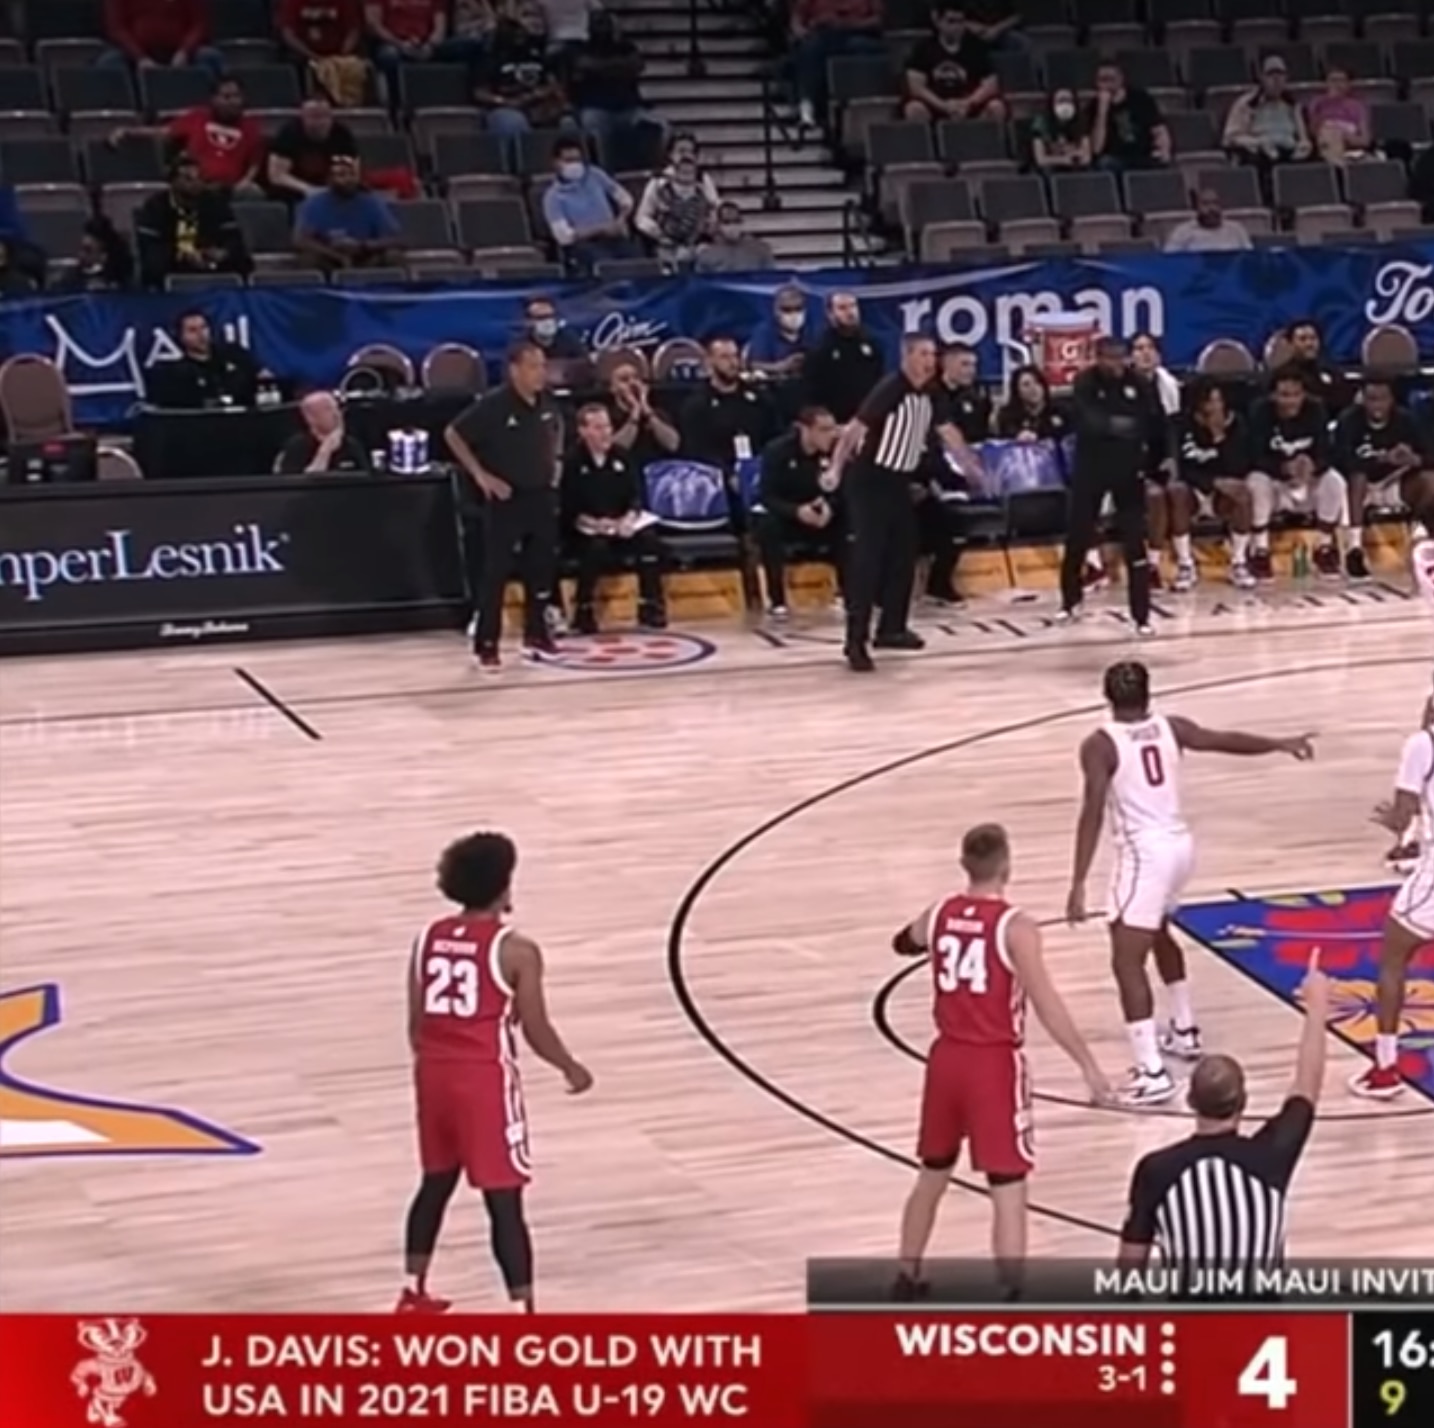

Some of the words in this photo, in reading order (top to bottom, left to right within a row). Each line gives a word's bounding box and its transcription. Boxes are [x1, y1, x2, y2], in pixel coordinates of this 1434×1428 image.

[1141, 744, 1165, 787] 0
[425, 955, 478, 1017] 23
[938, 934, 987, 993] 34
